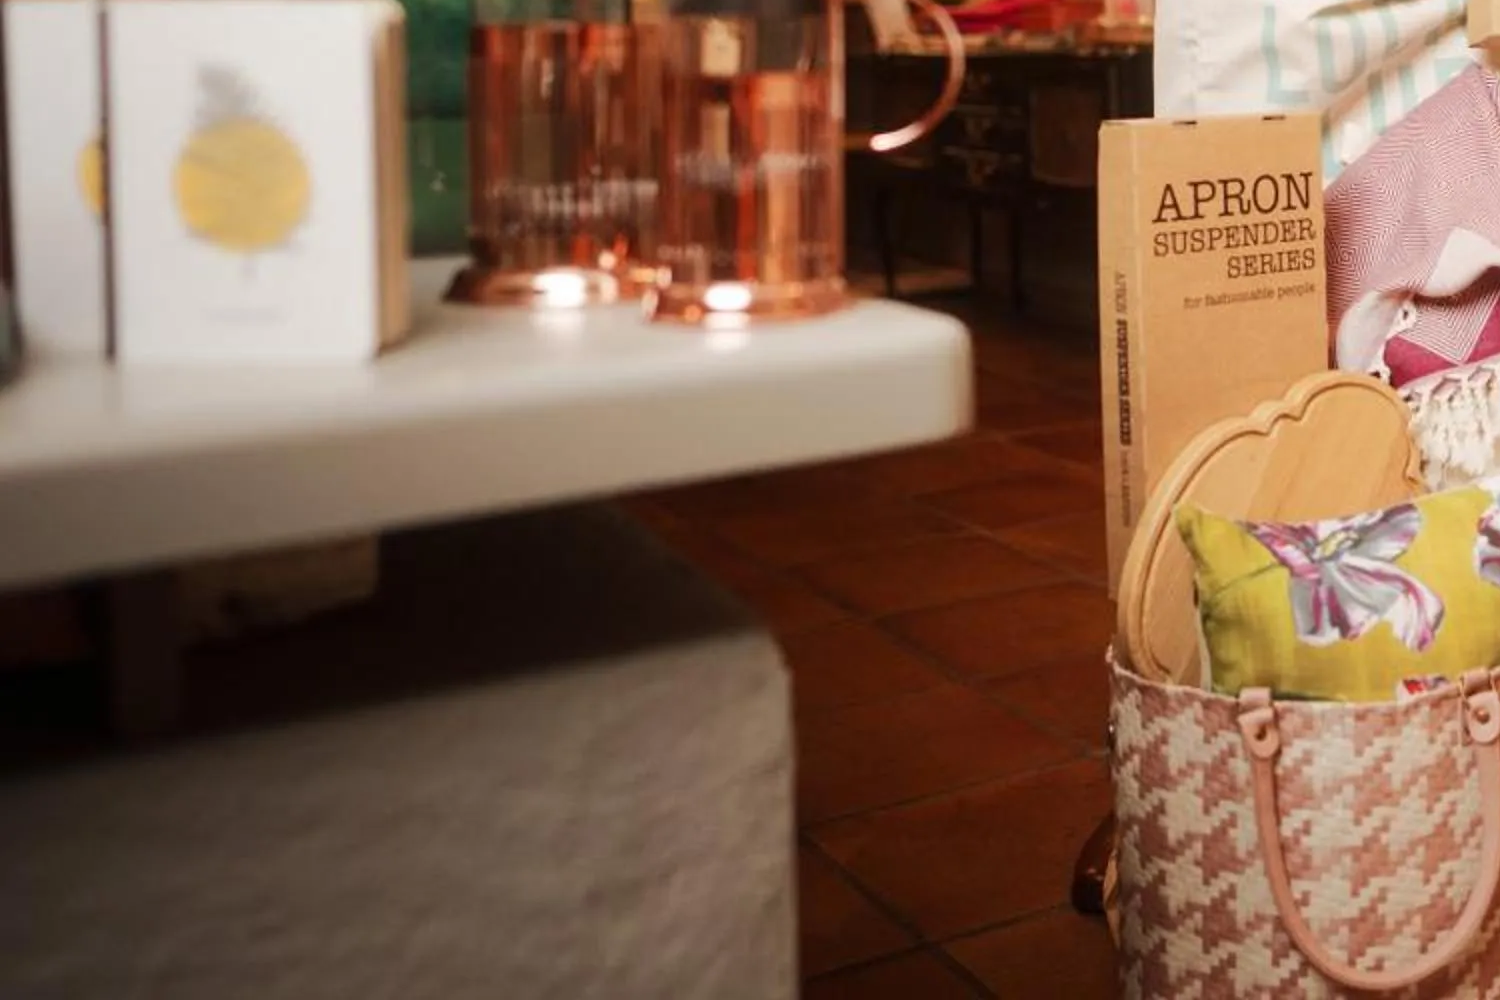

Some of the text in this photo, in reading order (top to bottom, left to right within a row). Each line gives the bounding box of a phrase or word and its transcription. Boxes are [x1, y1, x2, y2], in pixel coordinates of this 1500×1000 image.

[1152, 171, 1313, 223] APRON
[1153, 217, 1316, 257] SUSPENDER
[1227, 247, 1315, 279] SERIES
[1277, 283, 1316, 299] people
